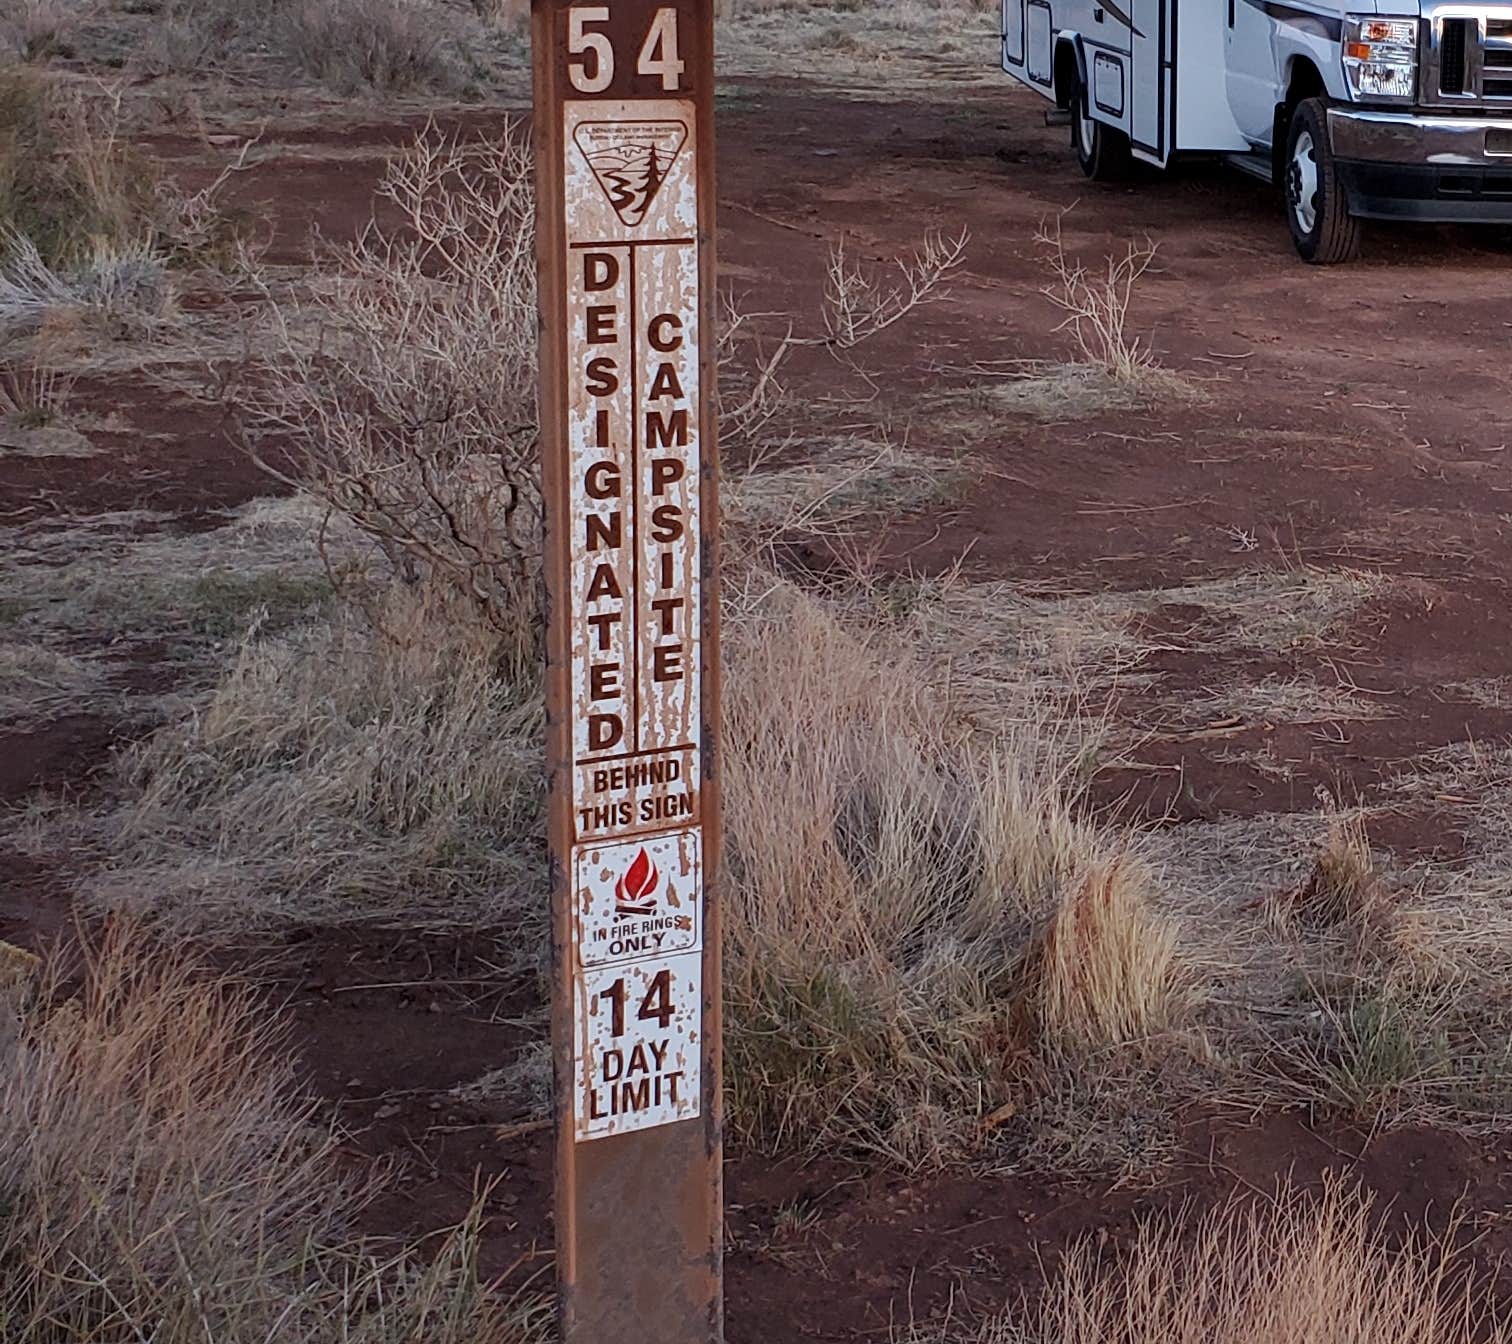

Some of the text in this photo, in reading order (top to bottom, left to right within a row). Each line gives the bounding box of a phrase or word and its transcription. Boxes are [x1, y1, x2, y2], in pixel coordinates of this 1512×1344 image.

[583, 252, 624, 752] DESIGNATED
[646, 313, 688, 683] CAMPSITE
[593, 759, 680, 793] BEHIND
[579, 792, 694, 832] THIS SIGN
[593, 915, 682, 942] IN FIRE RINGS
[609, 932, 666, 955] ONLY
[600, 969, 675, 1037] 14
[603, 1039, 670, 1082] DAY
[590, 1071, 683, 1120] LIMIT
